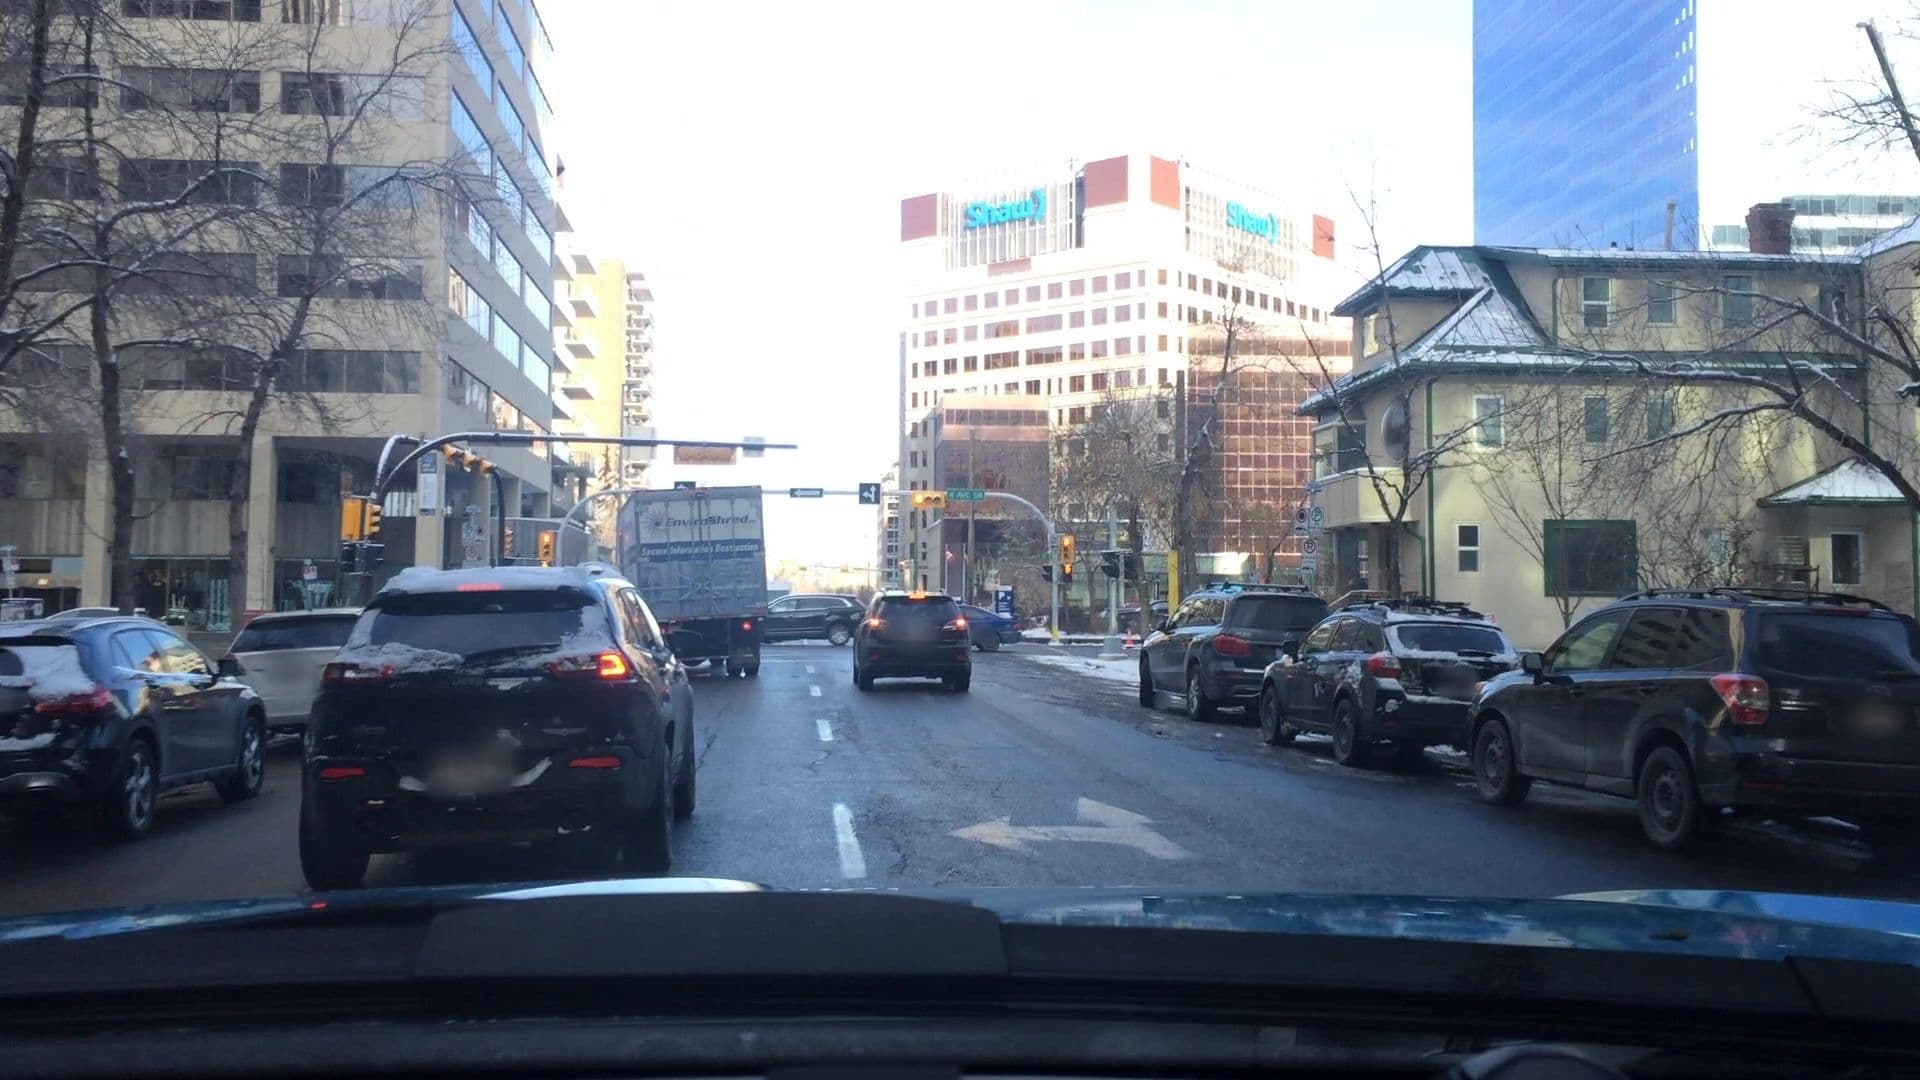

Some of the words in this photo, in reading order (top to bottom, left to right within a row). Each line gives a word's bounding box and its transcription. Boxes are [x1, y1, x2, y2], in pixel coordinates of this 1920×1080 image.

[965, 200, 1035, 230] Shaw
[1227, 201, 1269, 238] Shaw
[665, 515, 748, 527] EnviroShred
[715, 542, 759, 553] Destruction
